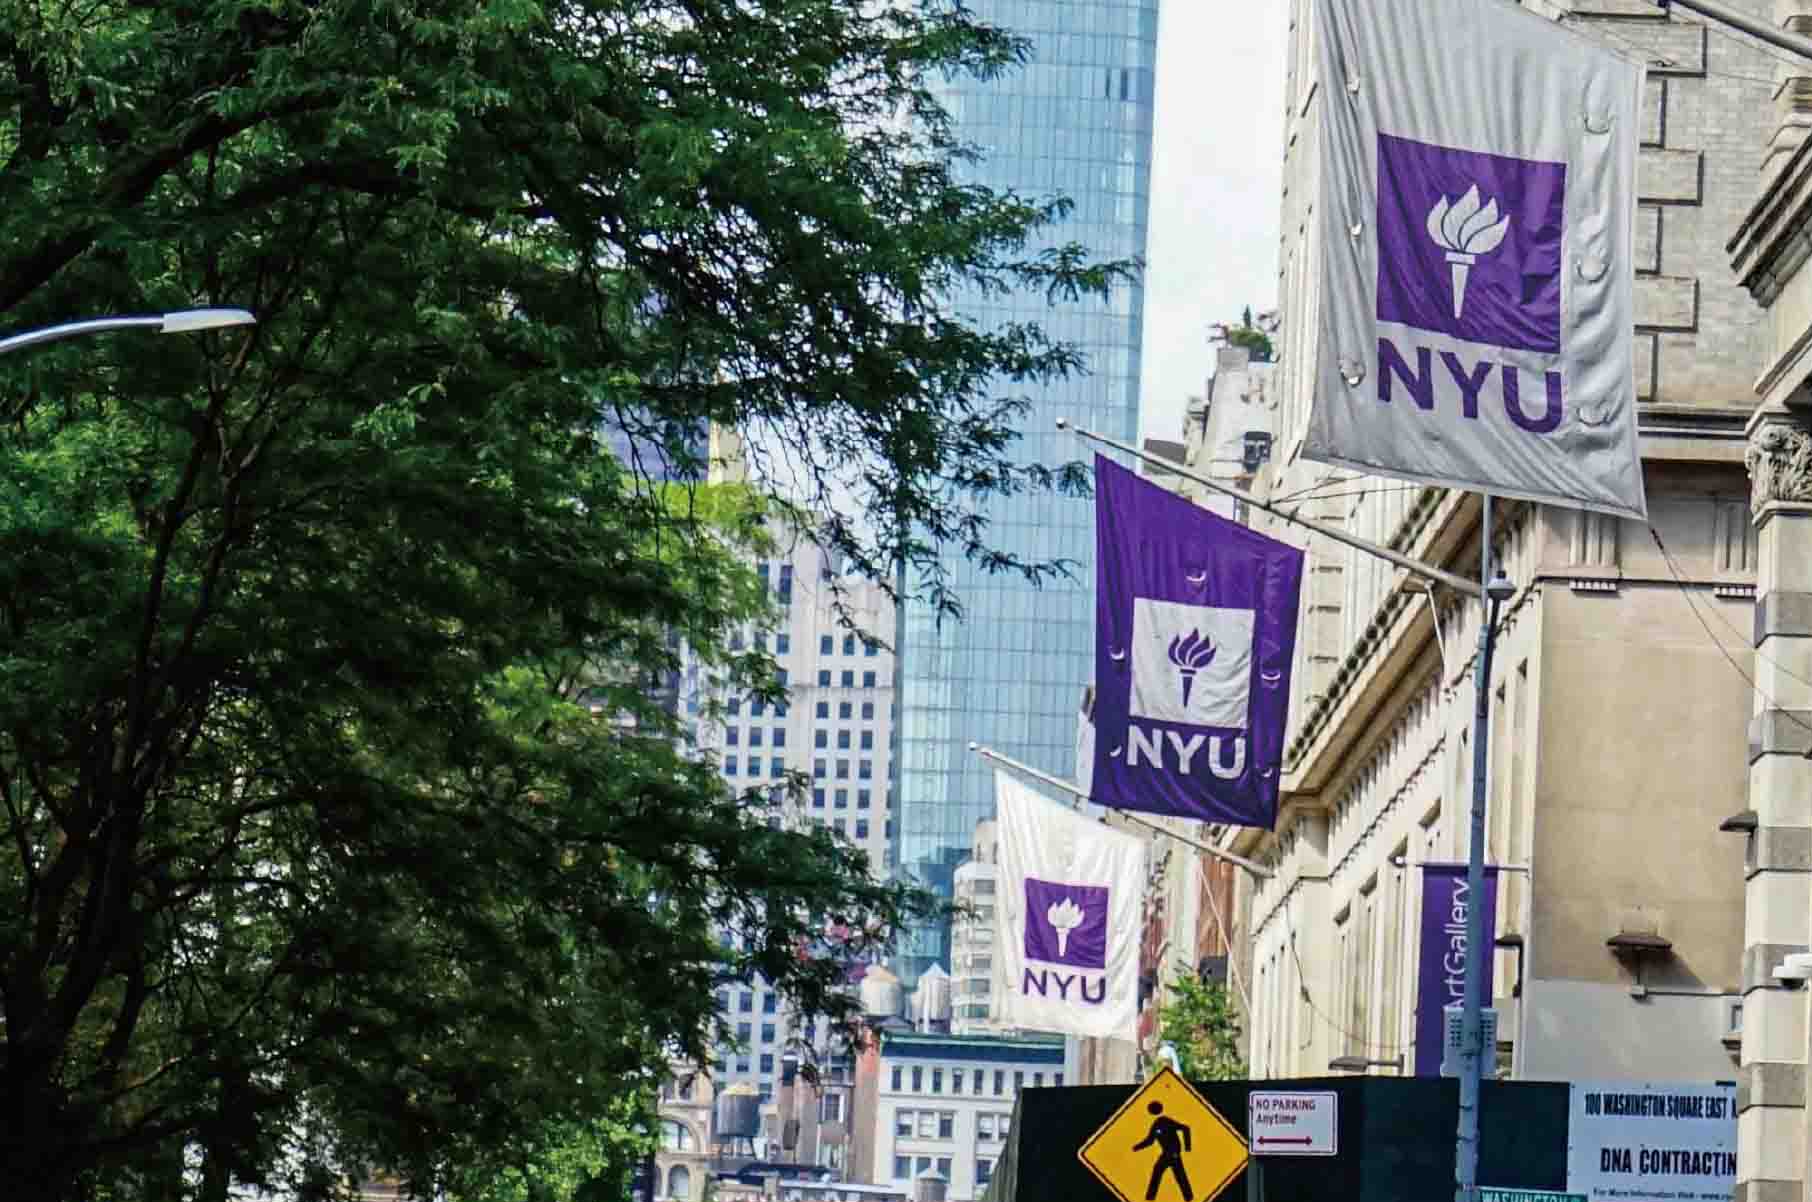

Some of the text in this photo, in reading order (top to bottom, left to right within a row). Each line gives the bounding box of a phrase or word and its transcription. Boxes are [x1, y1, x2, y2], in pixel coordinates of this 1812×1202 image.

[1376, 336, 1564, 434] NYU
[1126, 724, 1247, 780] NYU
[1023, 967, 1106, 1005] NYU
[1256, 1099, 1316, 1112] NO PARKING
[1585, 1093, 1601, 1116] 100
[1603, 1093, 1665, 1118] WASHINGTON
[1667, 1095, 1703, 1120] SQUARE
[1705, 1097, 1727, 1120] EAST
[1256, 1113, 1297, 1126] Anytime
[1600, 1147, 1632, 1174] DNA
